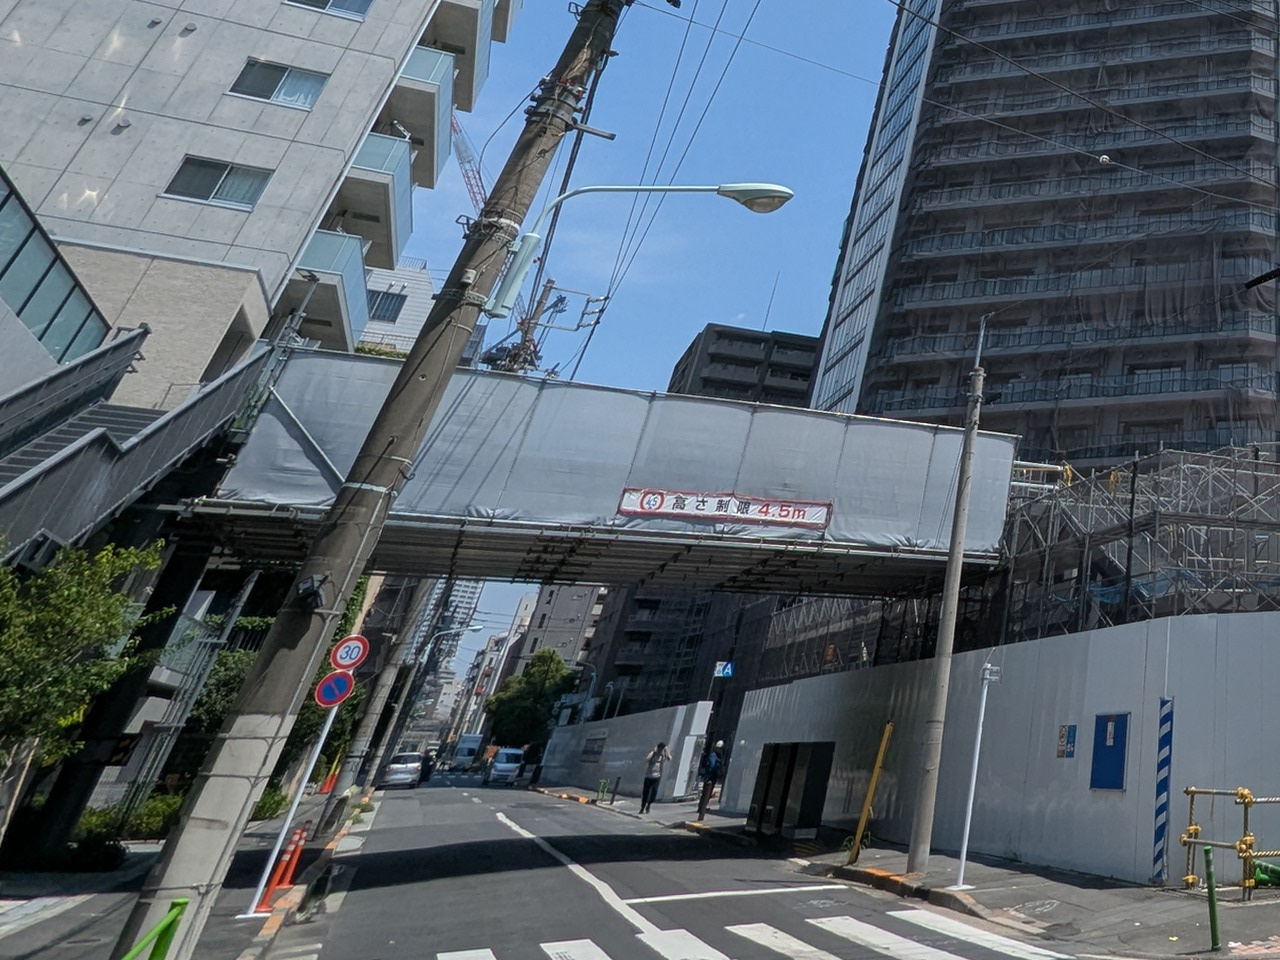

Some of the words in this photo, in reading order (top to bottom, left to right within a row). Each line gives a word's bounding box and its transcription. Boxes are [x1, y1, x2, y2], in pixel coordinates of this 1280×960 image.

[672, 494, 750, 515] 高さ制限
[758, 503, 806, 519] 4.5m
[340, 644, 362, 660] 30
